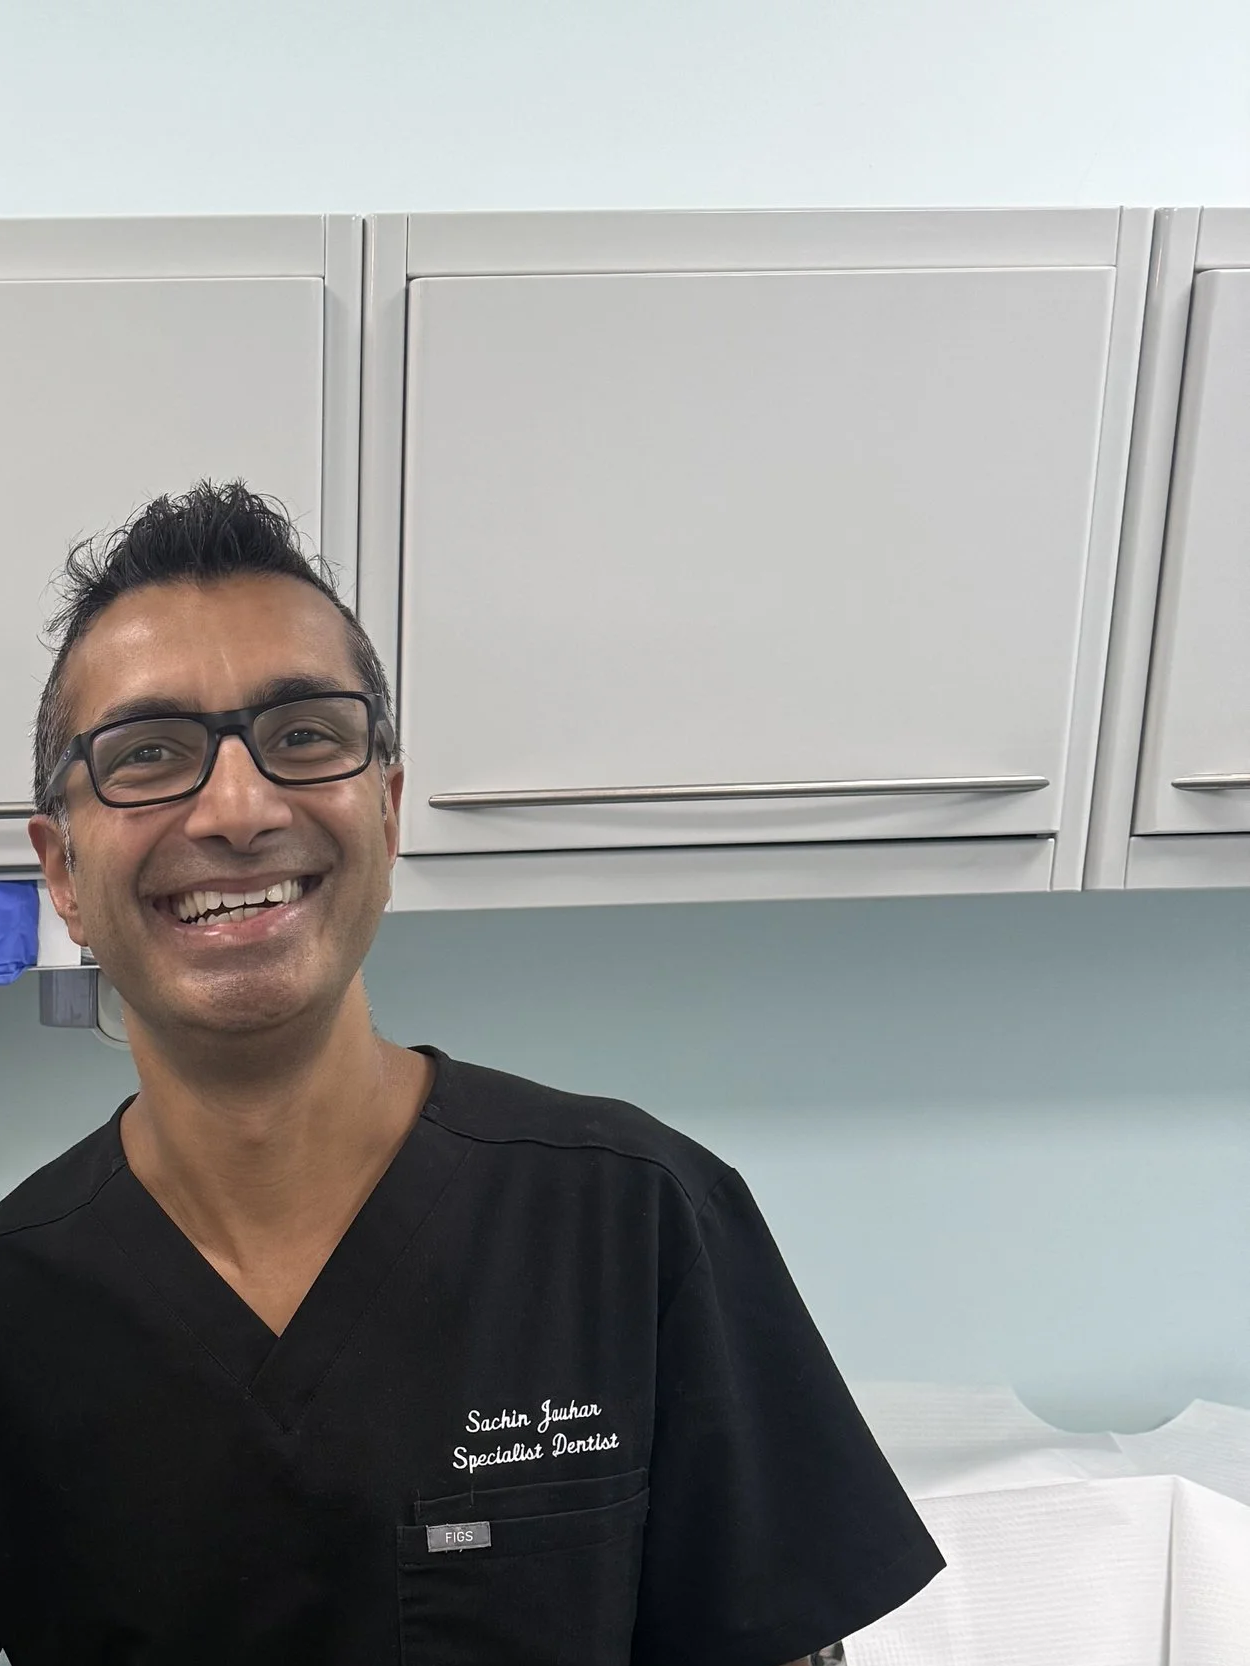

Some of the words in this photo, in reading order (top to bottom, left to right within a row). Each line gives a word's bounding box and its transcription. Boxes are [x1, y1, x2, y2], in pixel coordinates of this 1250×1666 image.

[465, 1409, 531, 1433] Sachin
[537, 1399, 602, 1433] Jauhar
[452, 1442, 544, 1474] Specialist
[552, 1432, 619, 1457] Dentist
[445, 1530, 474, 1544] FIGS
